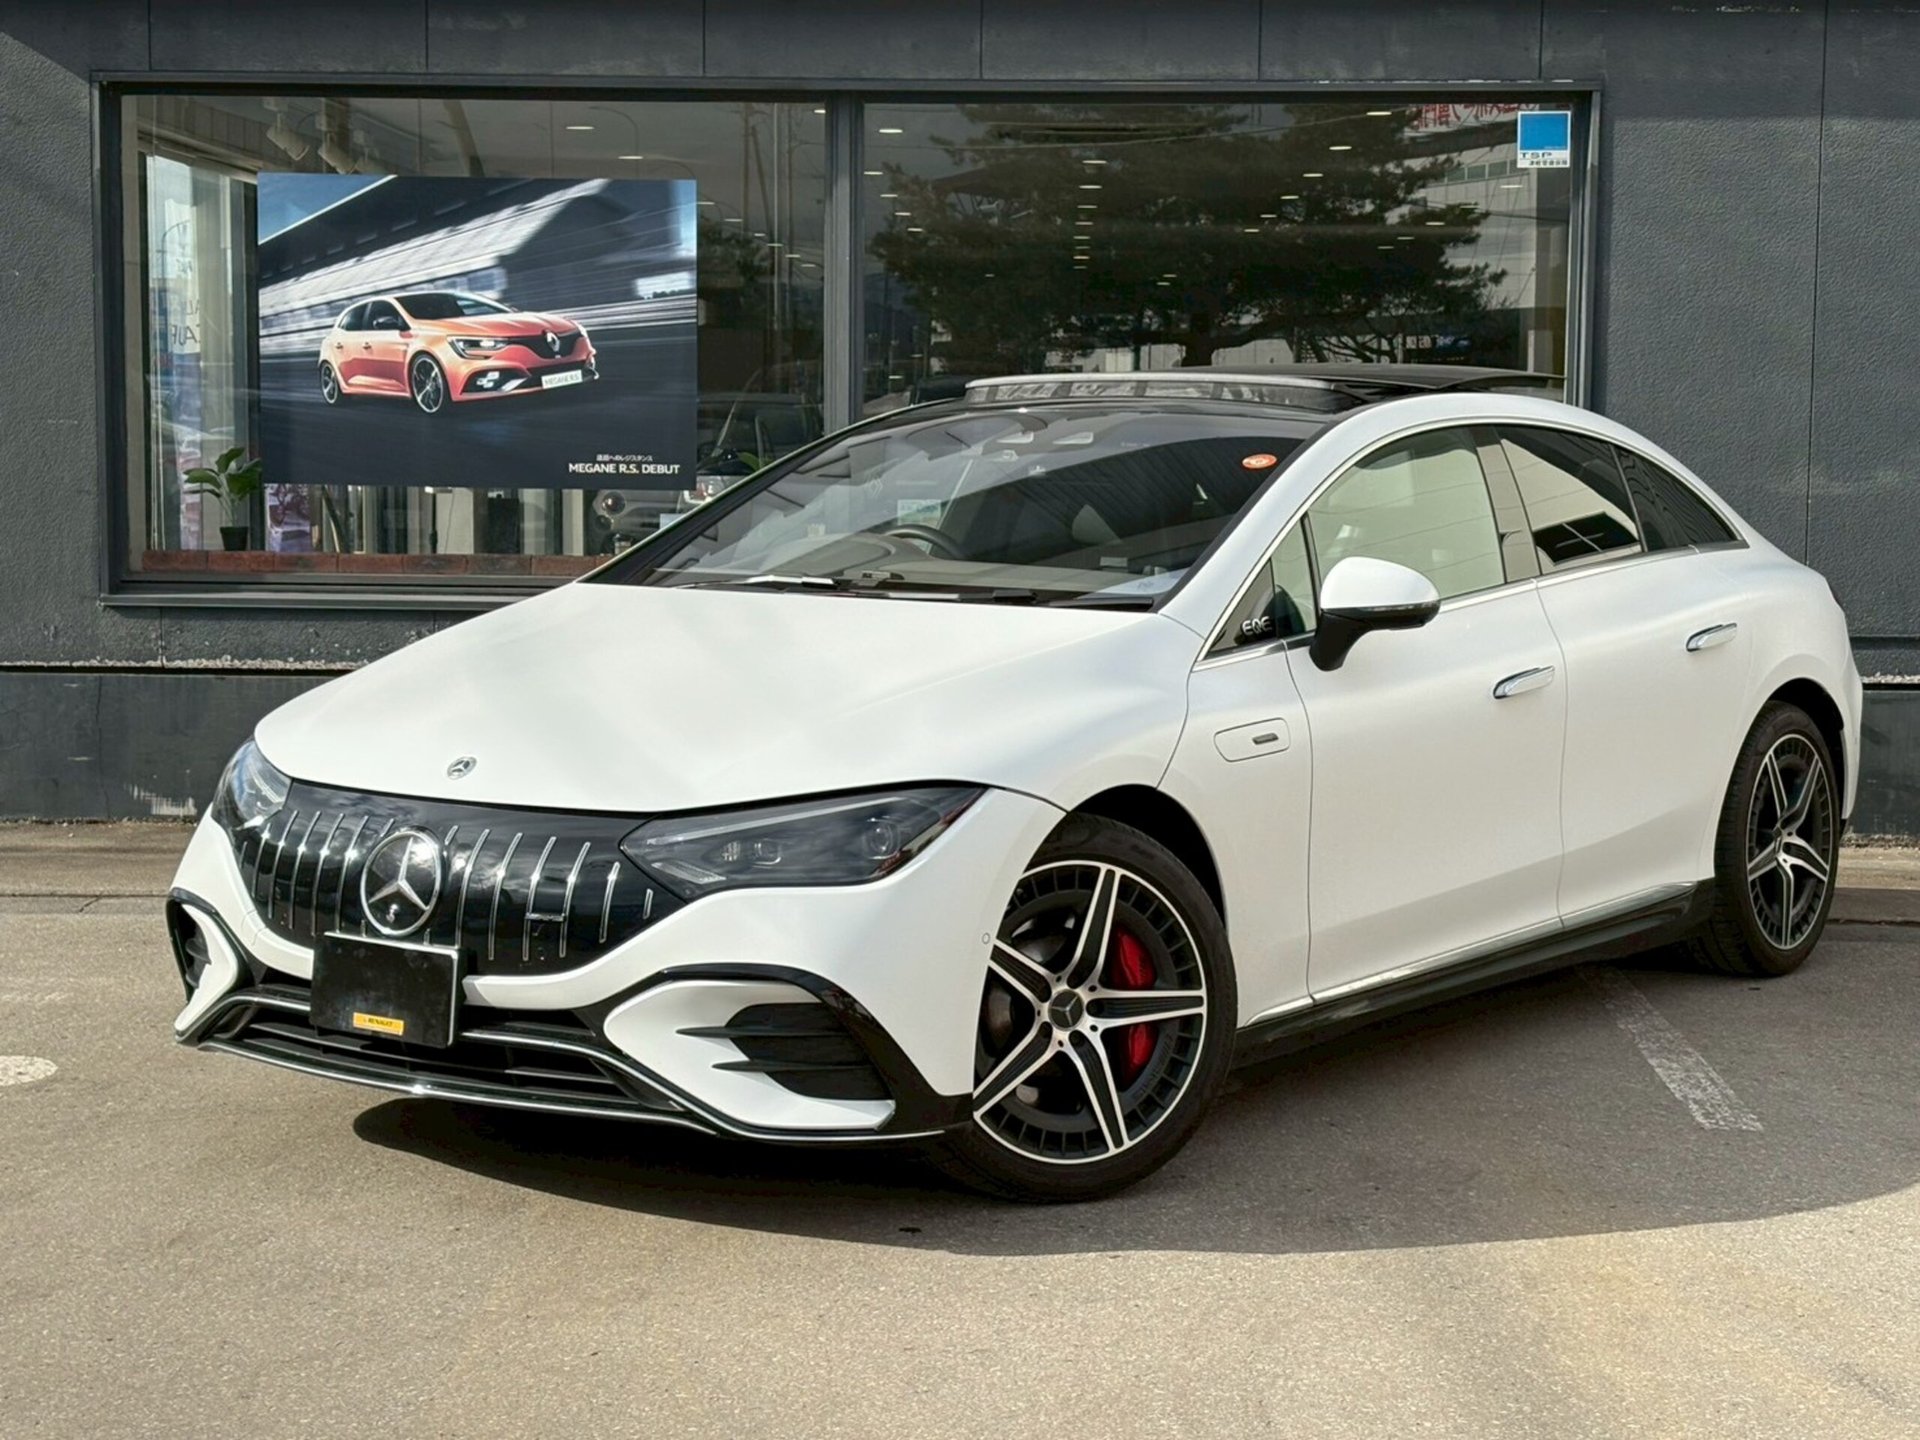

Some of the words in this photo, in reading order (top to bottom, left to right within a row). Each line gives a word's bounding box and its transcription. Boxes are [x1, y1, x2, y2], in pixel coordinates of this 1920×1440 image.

[1520, 151, 1553, 159] TSP
[568, 463, 616, 473] MEGANE
[619, 464, 639, 473] R.S.
[642, 464, 680, 474] DEBUT
[1242, 616, 1272, 636] EQE
